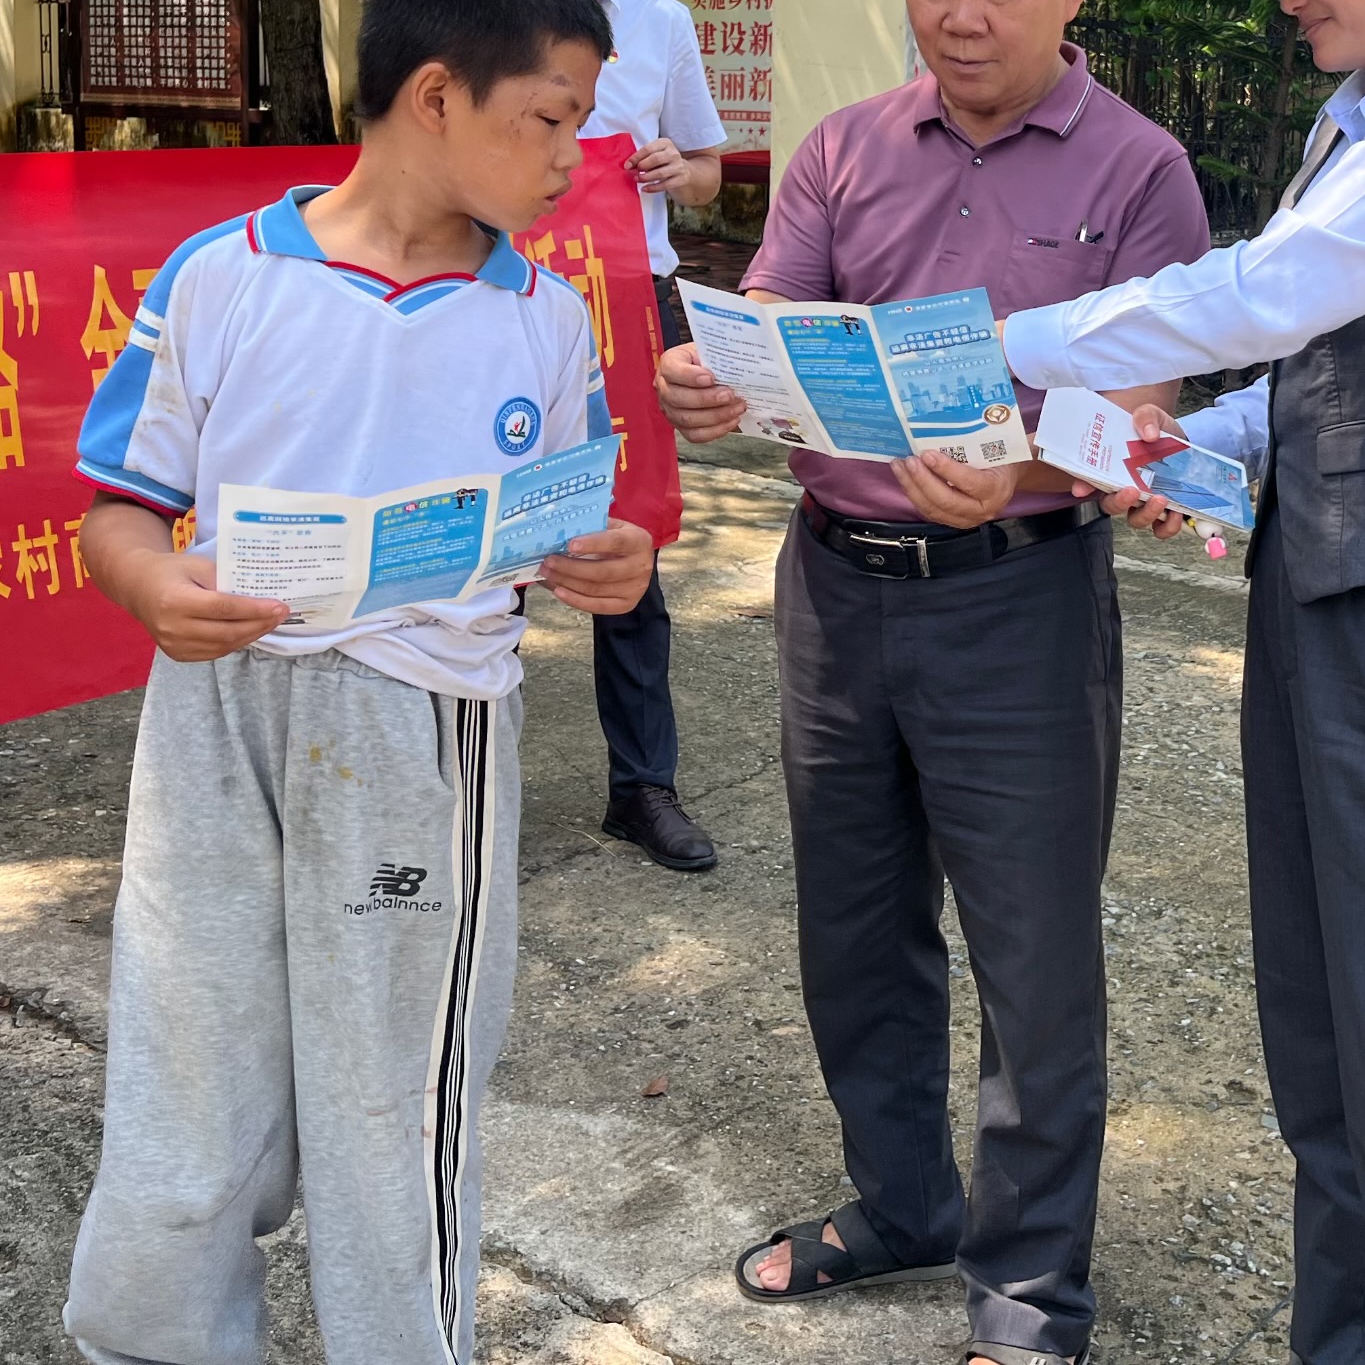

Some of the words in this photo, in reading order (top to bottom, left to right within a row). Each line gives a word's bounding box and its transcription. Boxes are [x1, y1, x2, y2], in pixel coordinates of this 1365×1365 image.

[503, 439, 526, 450] SPORT
[1088, 412, 1106, 468] 征信宣传手册
